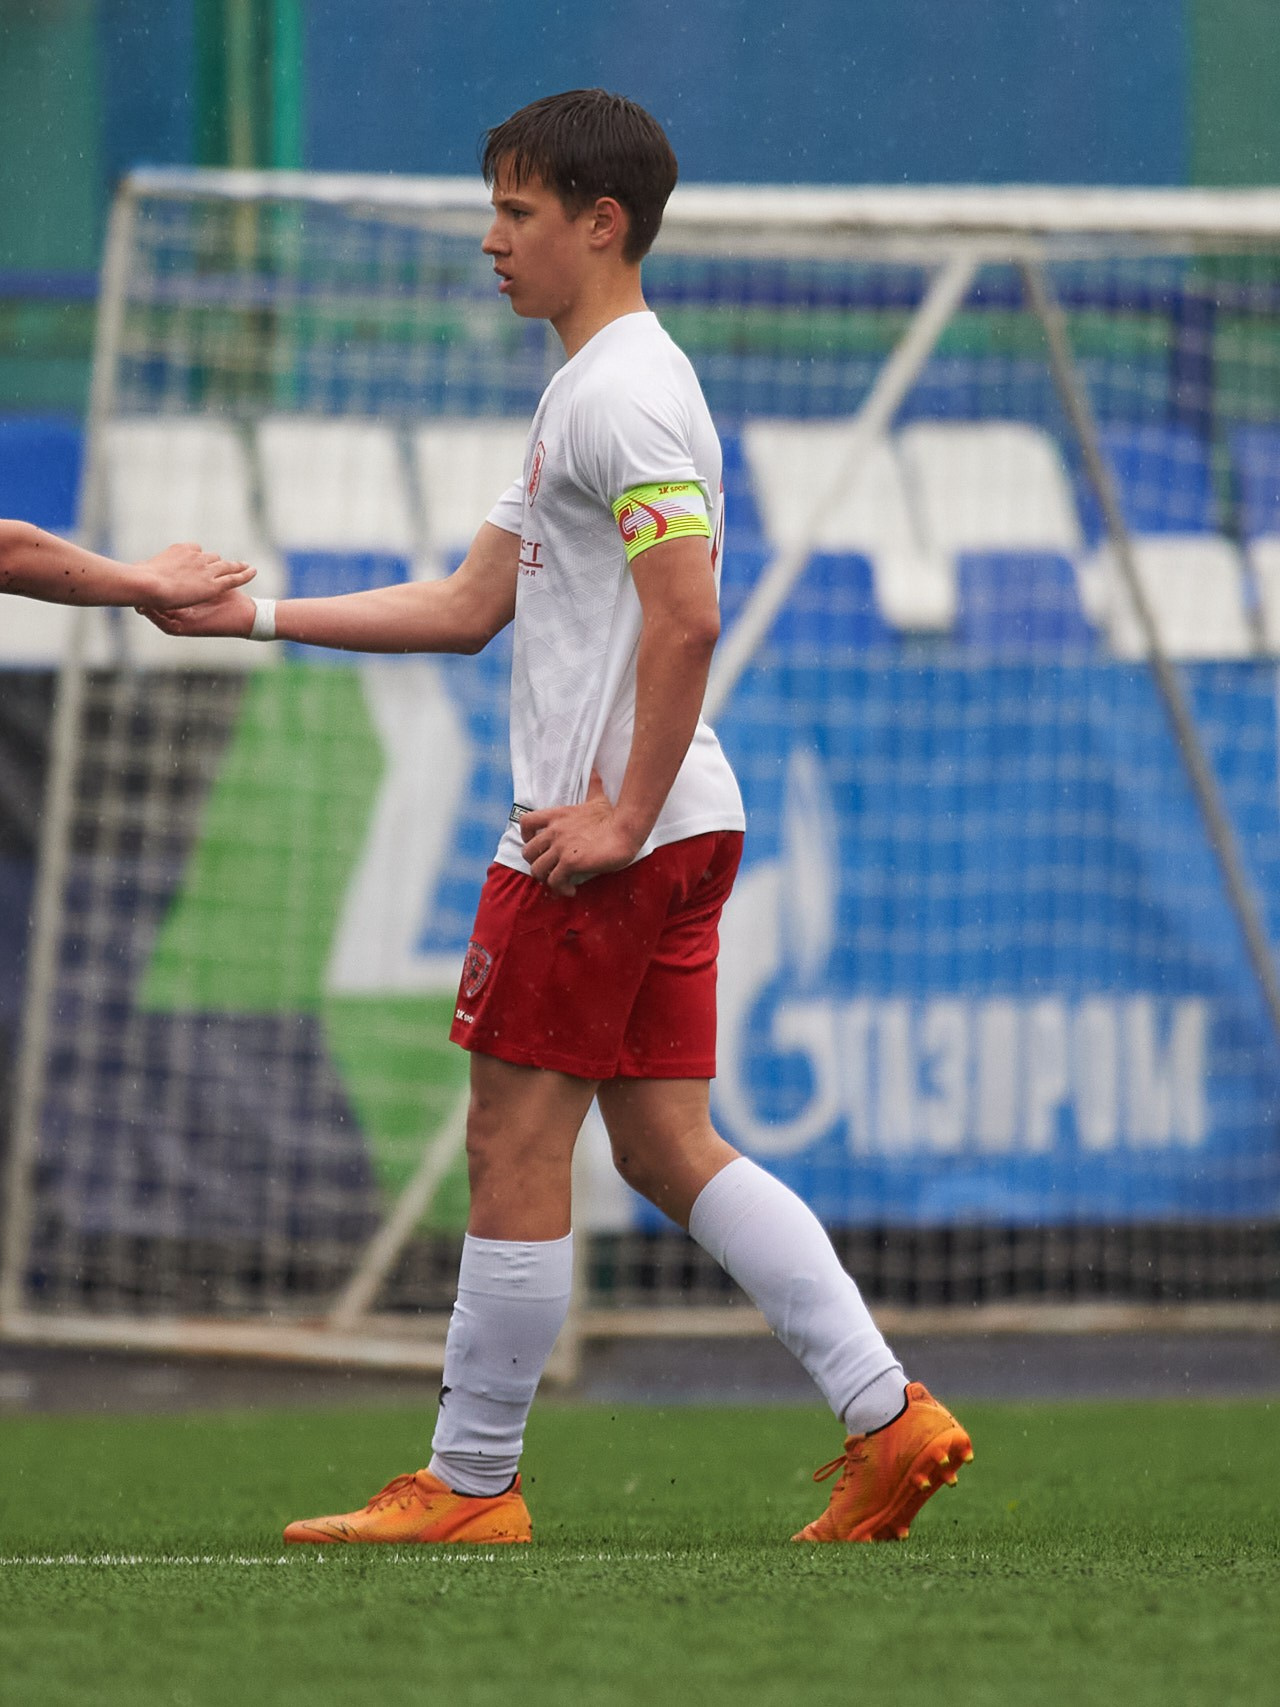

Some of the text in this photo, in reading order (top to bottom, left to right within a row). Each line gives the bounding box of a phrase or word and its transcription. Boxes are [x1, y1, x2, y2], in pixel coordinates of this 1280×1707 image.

[658, 485, 689, 495] 2K SPORT
[618, 502, 640, 545] C
